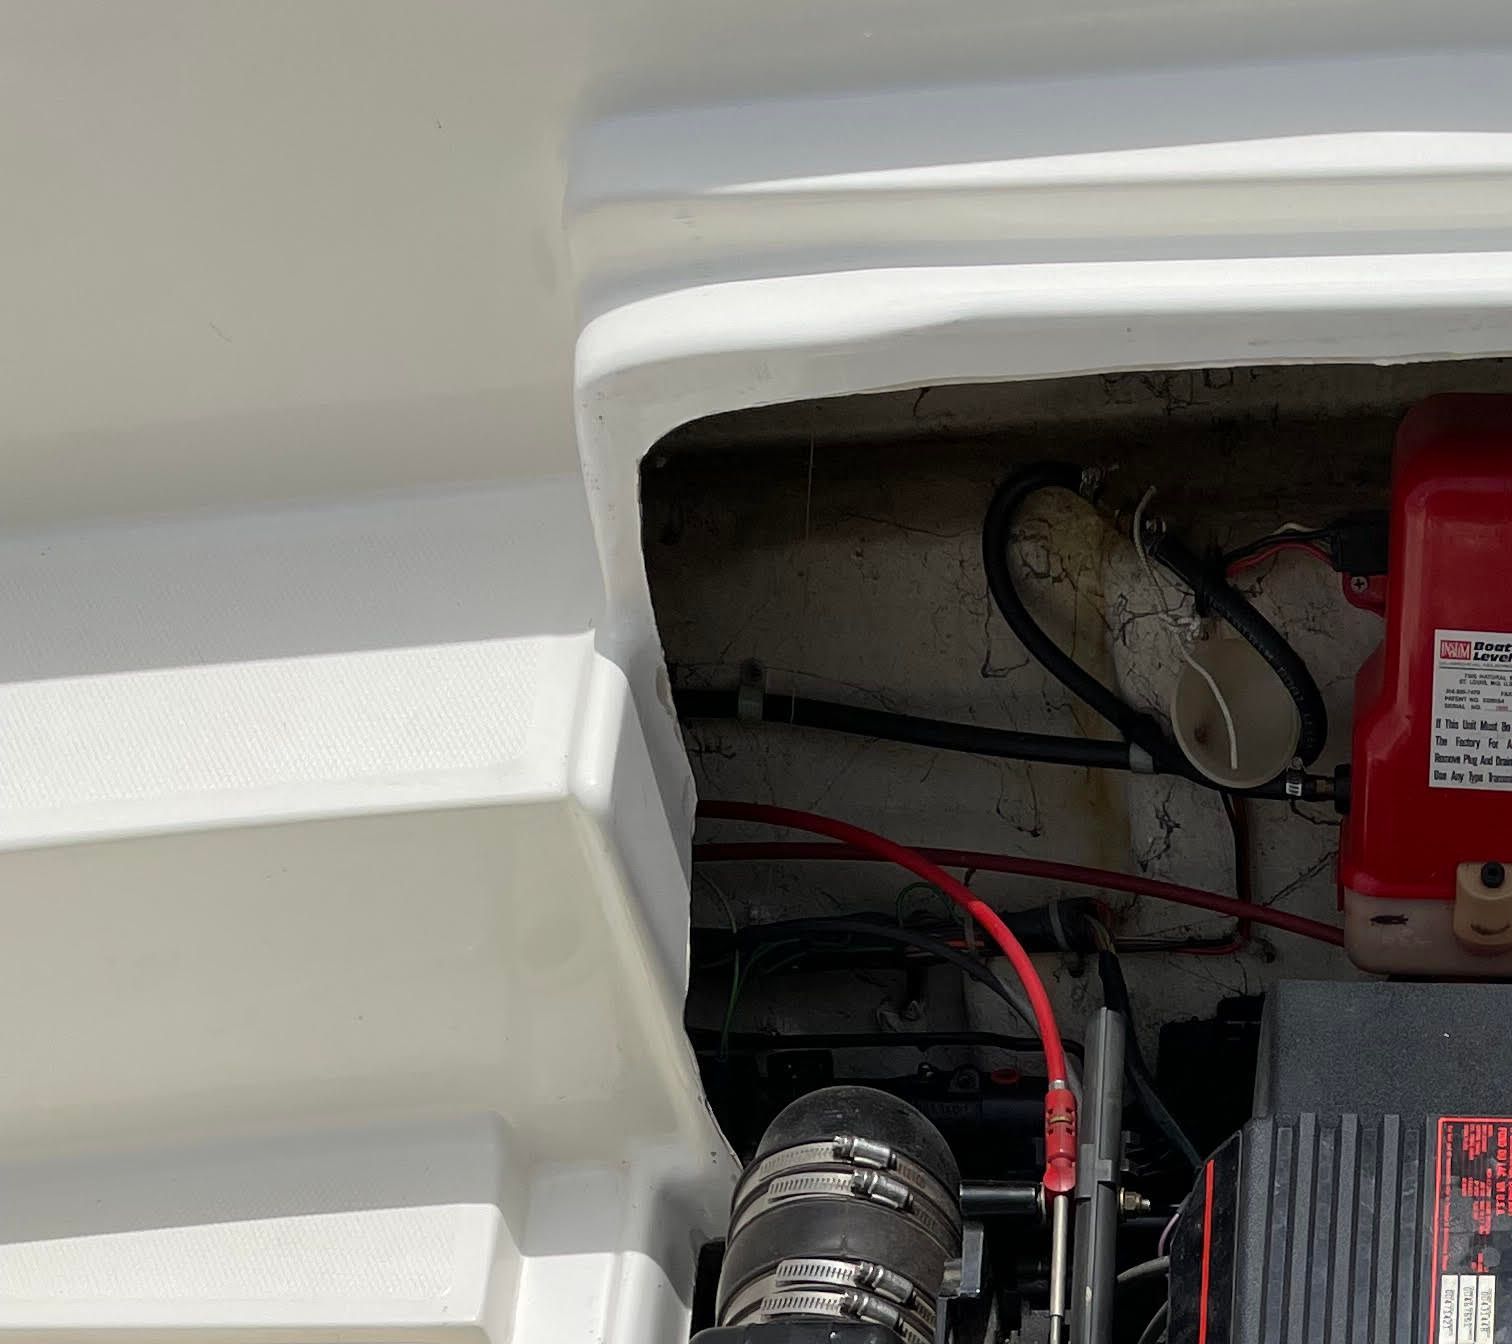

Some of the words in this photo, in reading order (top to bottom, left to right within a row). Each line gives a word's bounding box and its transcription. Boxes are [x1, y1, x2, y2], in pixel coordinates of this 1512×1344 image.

[1473, 641, 1512, 652] Boat
[1436, 718, 1441, 729] If
[1445, 719, 1459, 729] This
[1462, 719, 1476, 730] Unit
[1480, 720, 1498, 732] Must
[1501, 721, 1511, 732] Be
[1435, 736, 1448, 746] The
[1455, 737, 1480, 750] Factory
[1488, 738, 1499, 749] For
[1434, 752, 1460, 764] Remove
[1463, 754, 1478, 766] Plug
[1480, 755, 1493, 766] And
[1495, 756, 1512, 767] Drain
[1451, 770, 1464, 783] Any
[1468, 771, 1483, 784] Type
